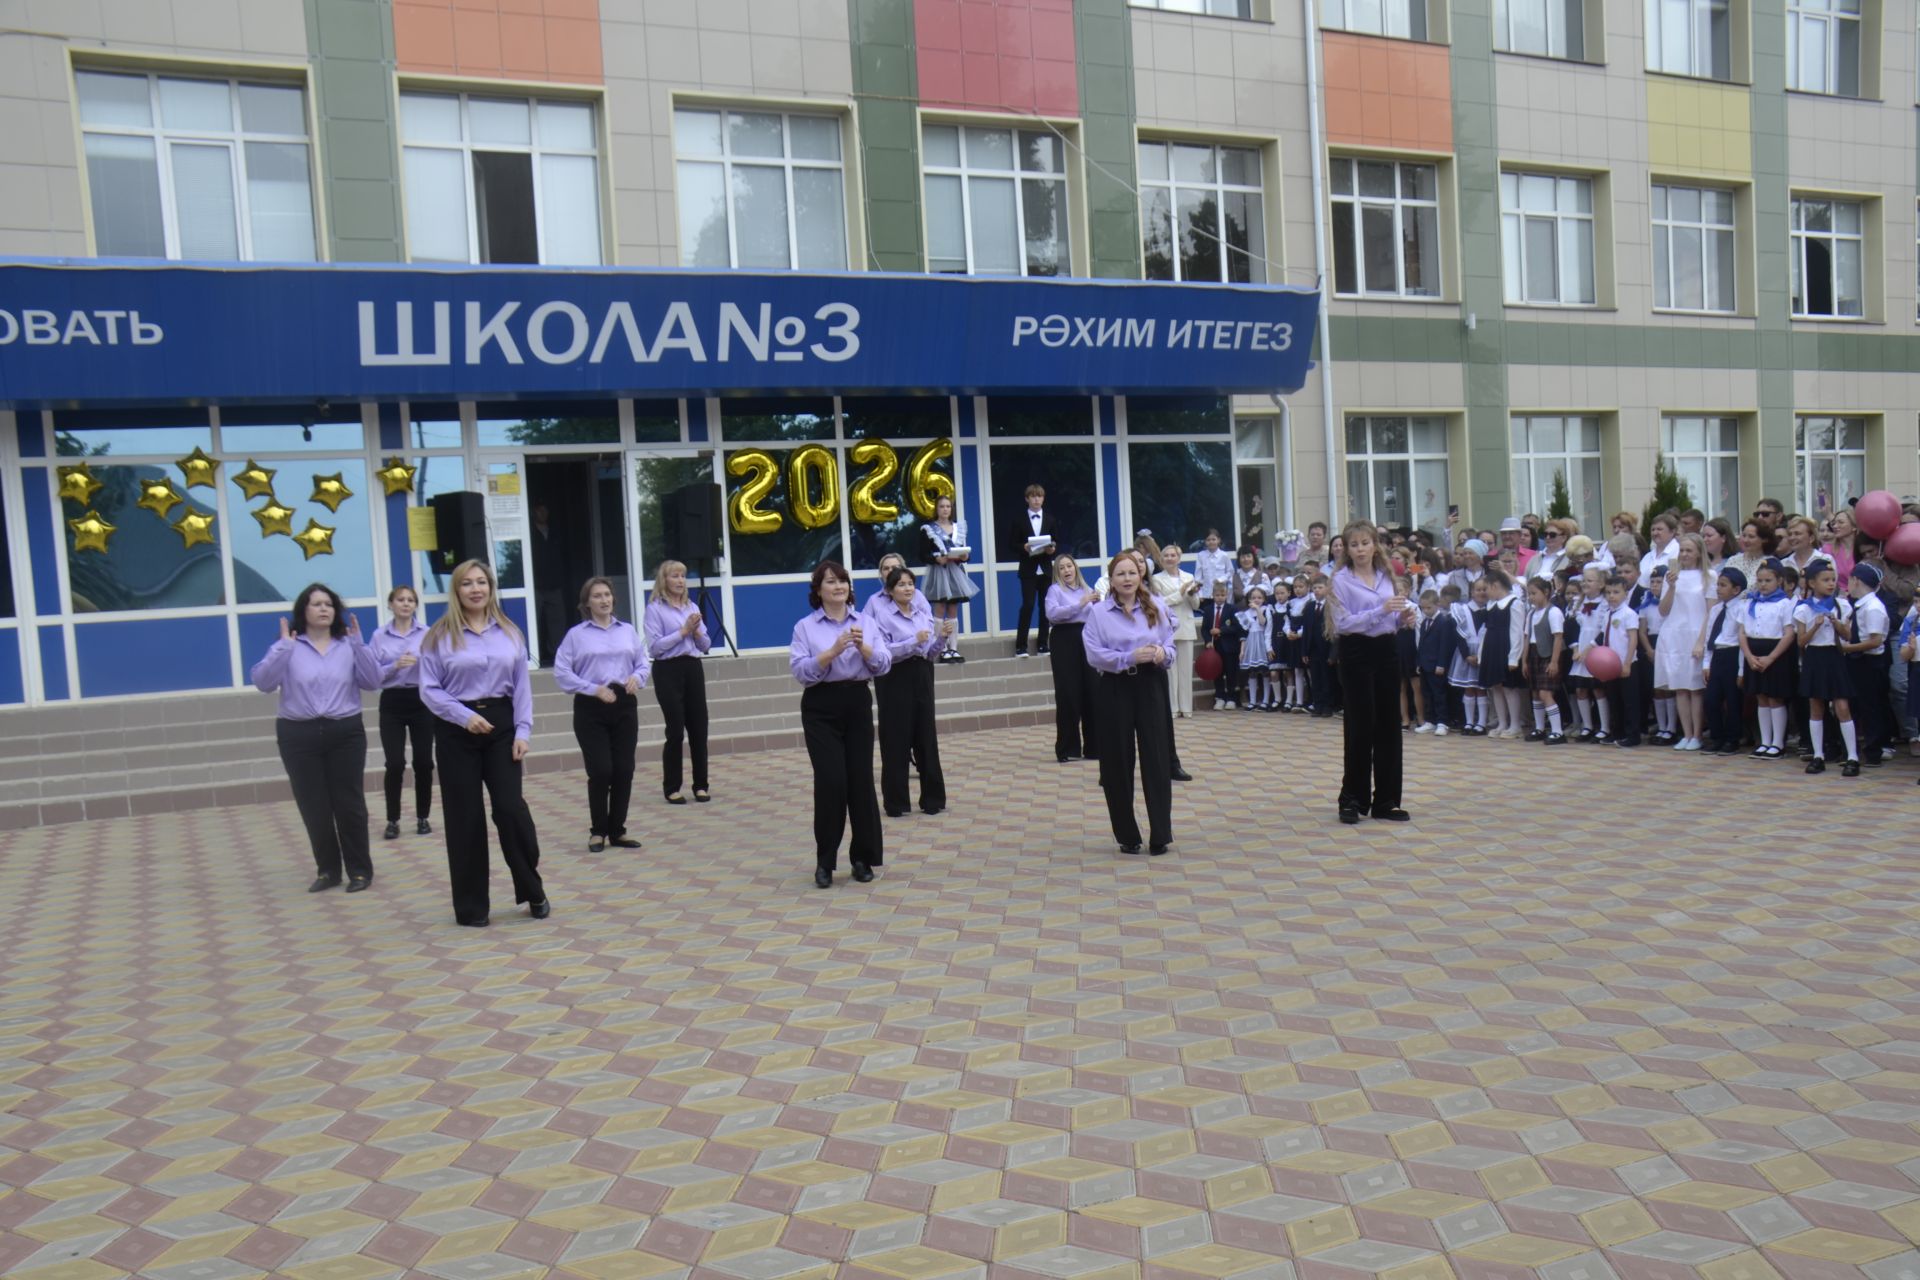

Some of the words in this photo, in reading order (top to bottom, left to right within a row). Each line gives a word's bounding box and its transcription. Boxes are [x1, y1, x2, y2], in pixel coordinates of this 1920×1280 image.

[1012, 314, 1156, 348] РӘХИМ
[1167, 319, 1293, 351] ИТЕГЕЗ
[727, 437, 955, 535] 2026
